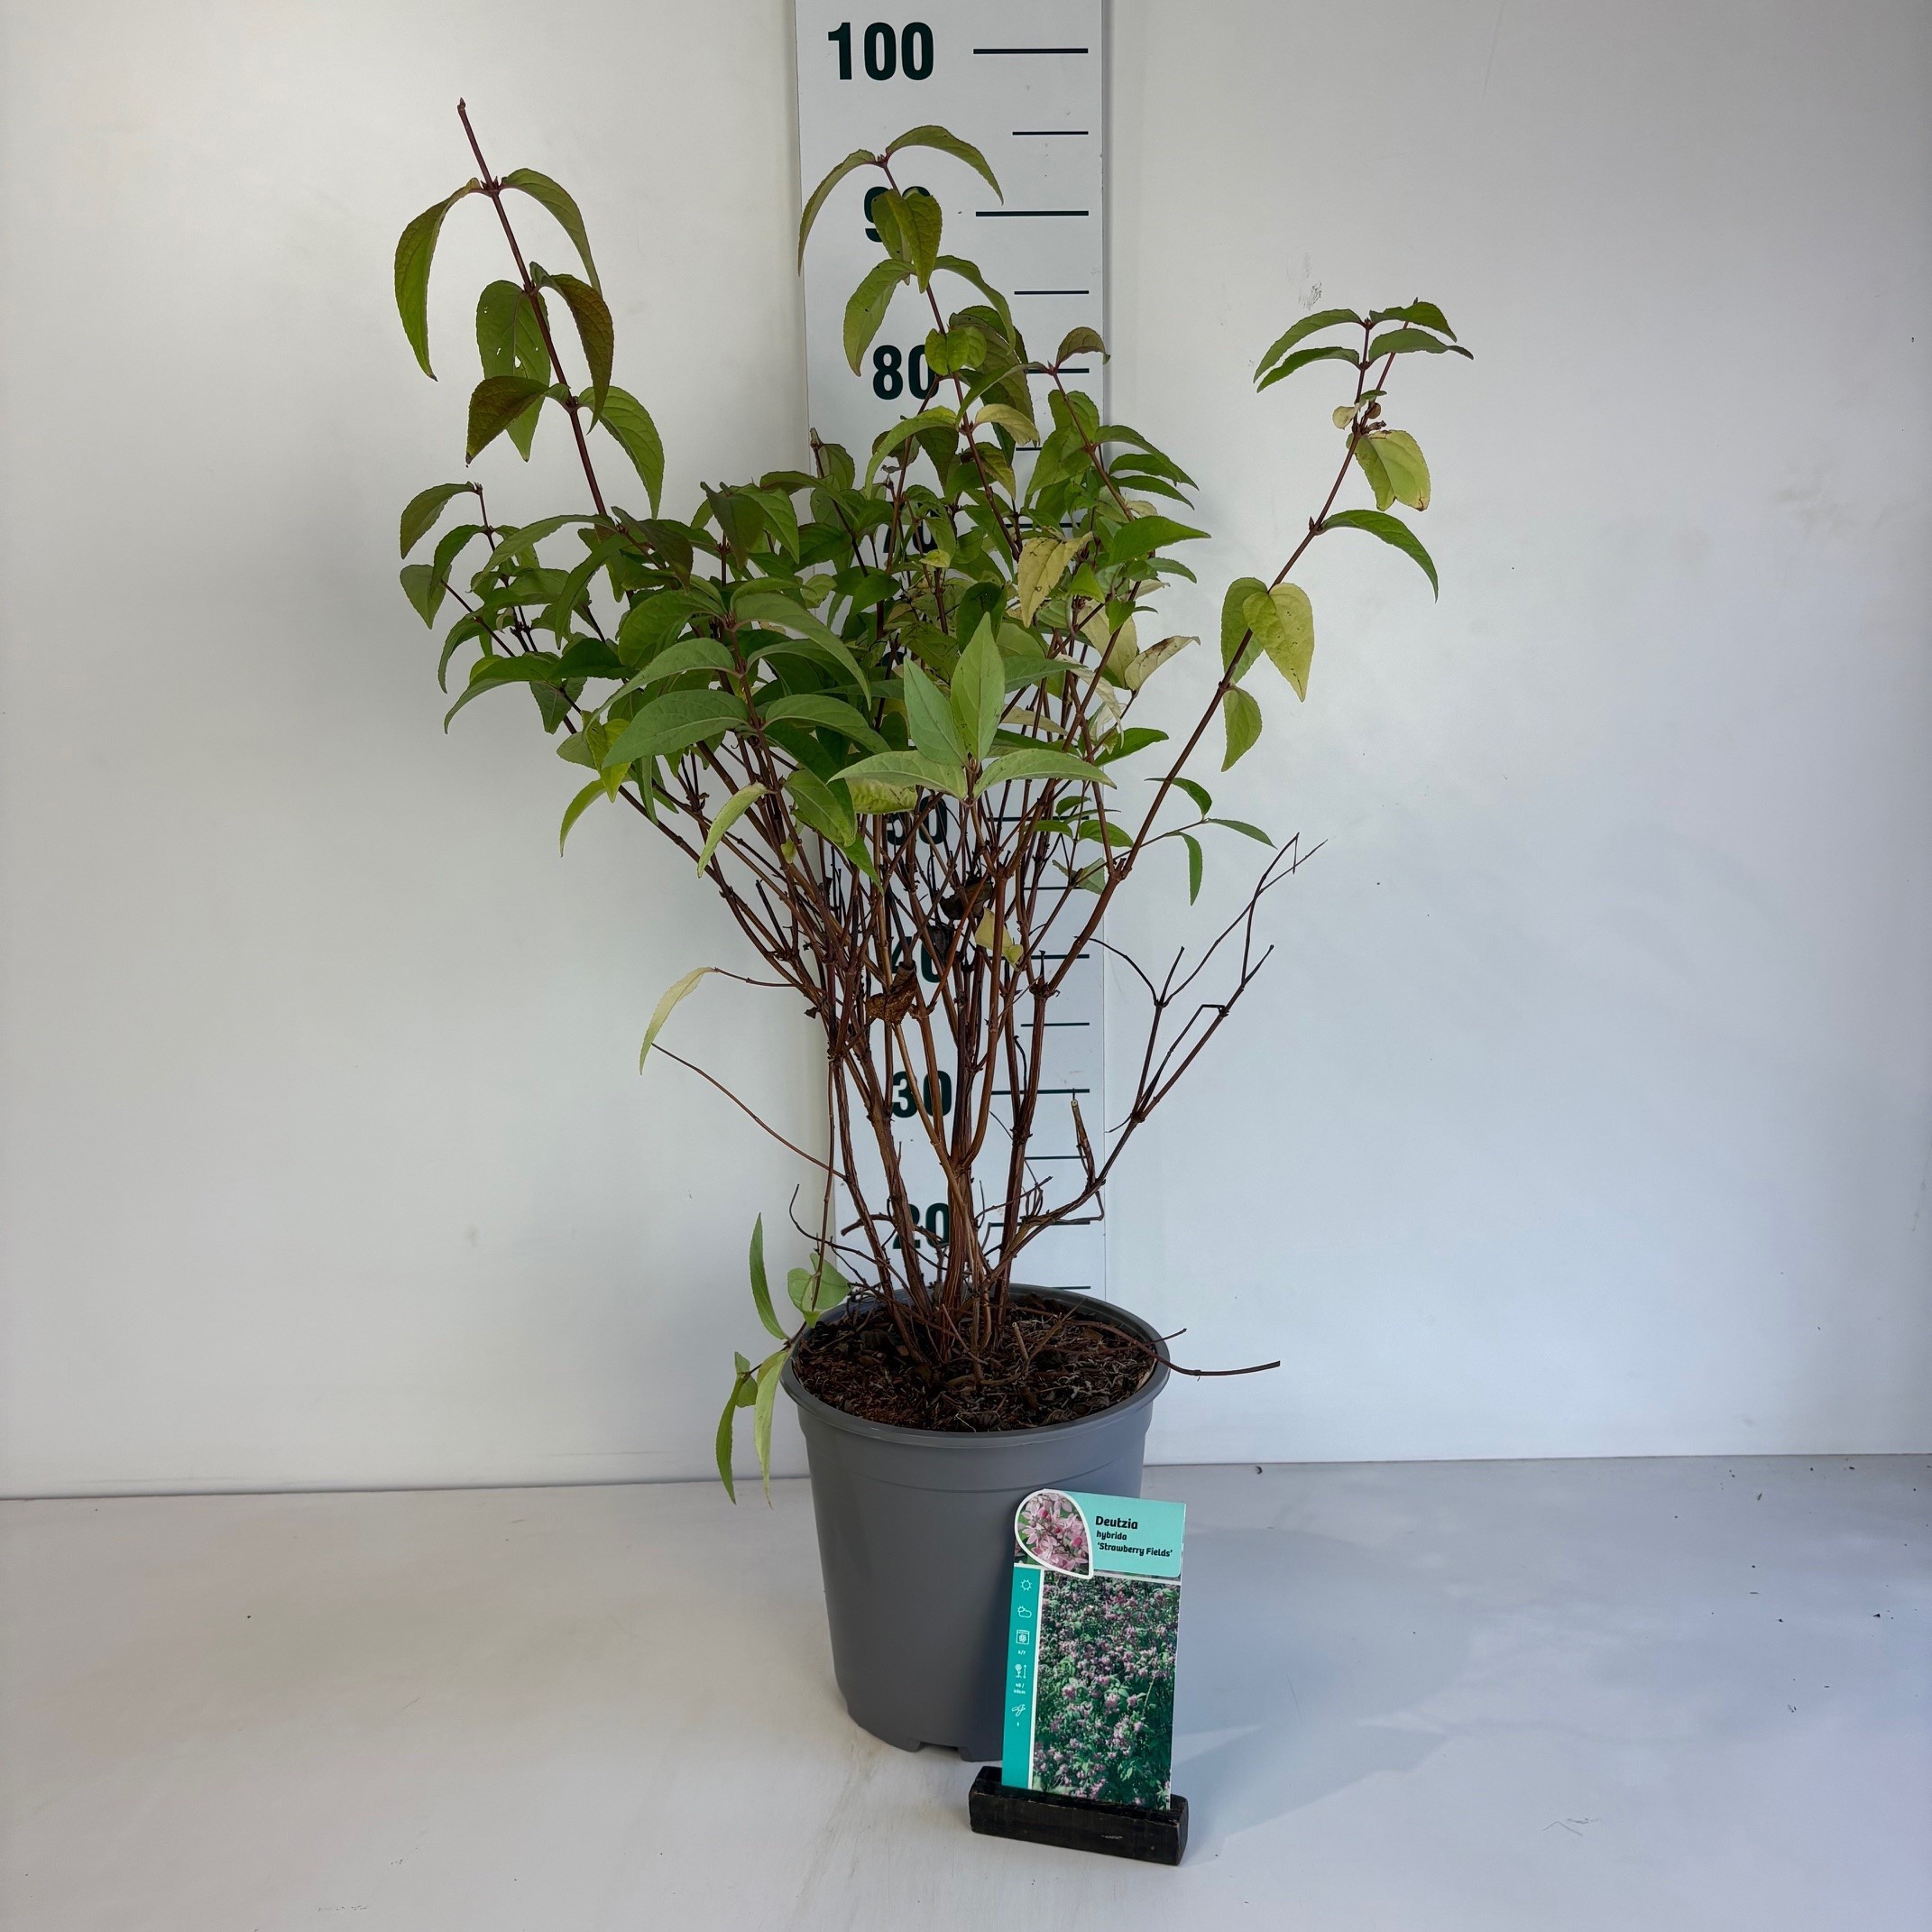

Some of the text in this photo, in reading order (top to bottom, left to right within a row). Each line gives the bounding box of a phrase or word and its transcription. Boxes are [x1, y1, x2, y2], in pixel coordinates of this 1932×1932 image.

[827, 22, 934, 81] 100
[872, 344, 940, 400] 80
[892, 1070, 952, 1118] 30
[1095, 1515, 1138, 1530] Deutzia
[1096, 1530, 1127, 1541] hybrida
